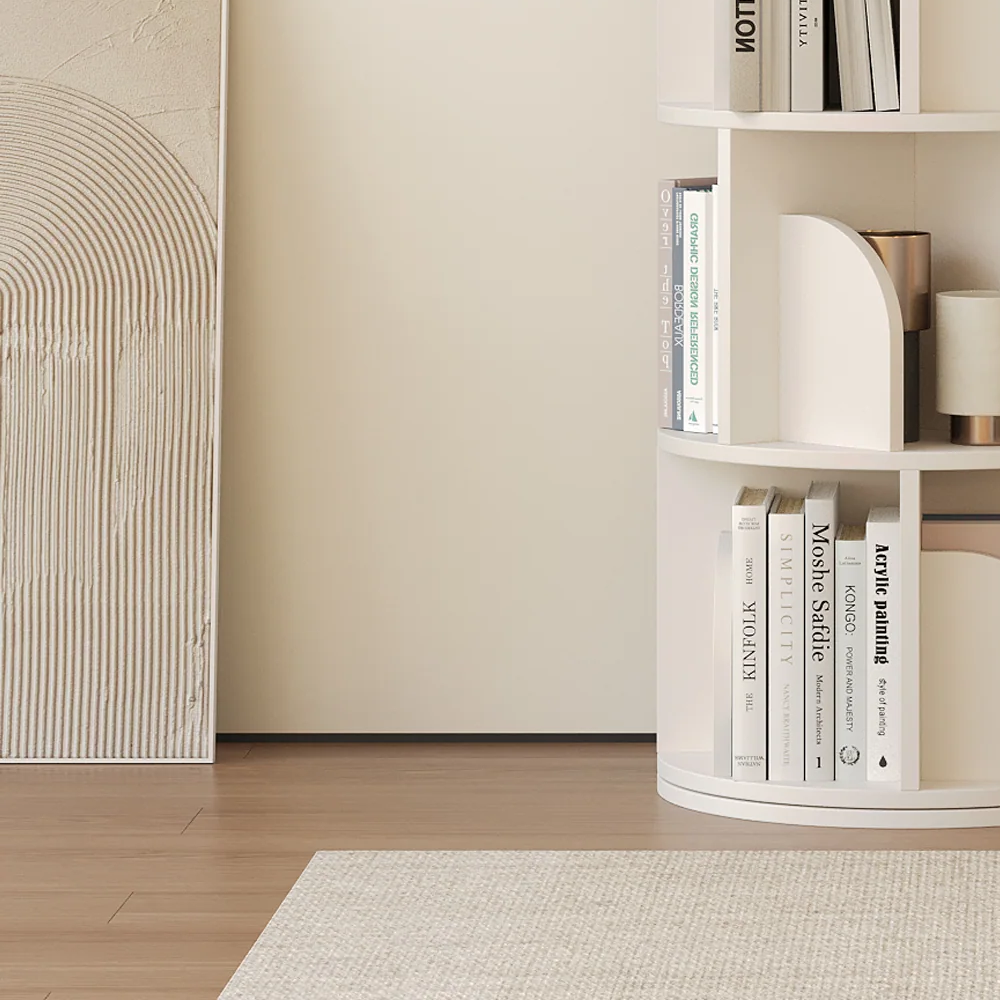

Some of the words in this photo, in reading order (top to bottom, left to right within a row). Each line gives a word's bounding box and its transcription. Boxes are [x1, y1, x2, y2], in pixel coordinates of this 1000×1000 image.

[811, 524, 830, 592] Moshe
[874, 544, 889, 595] Acrylic
[780, 534, 793, 666] SIMPLICITY
[844, 585, 856, 636] KONGO:
[743, 601, 756, 681] KINFOLK
[811, 600, 830, 662] Safdie
[874, 601, 889, 665] painting
[815, 675, 823, 704] Modern
[877, 678, 887, 695] style
[815, 706, 823, 745] Architects
[877, 707, 887, 736] painting
